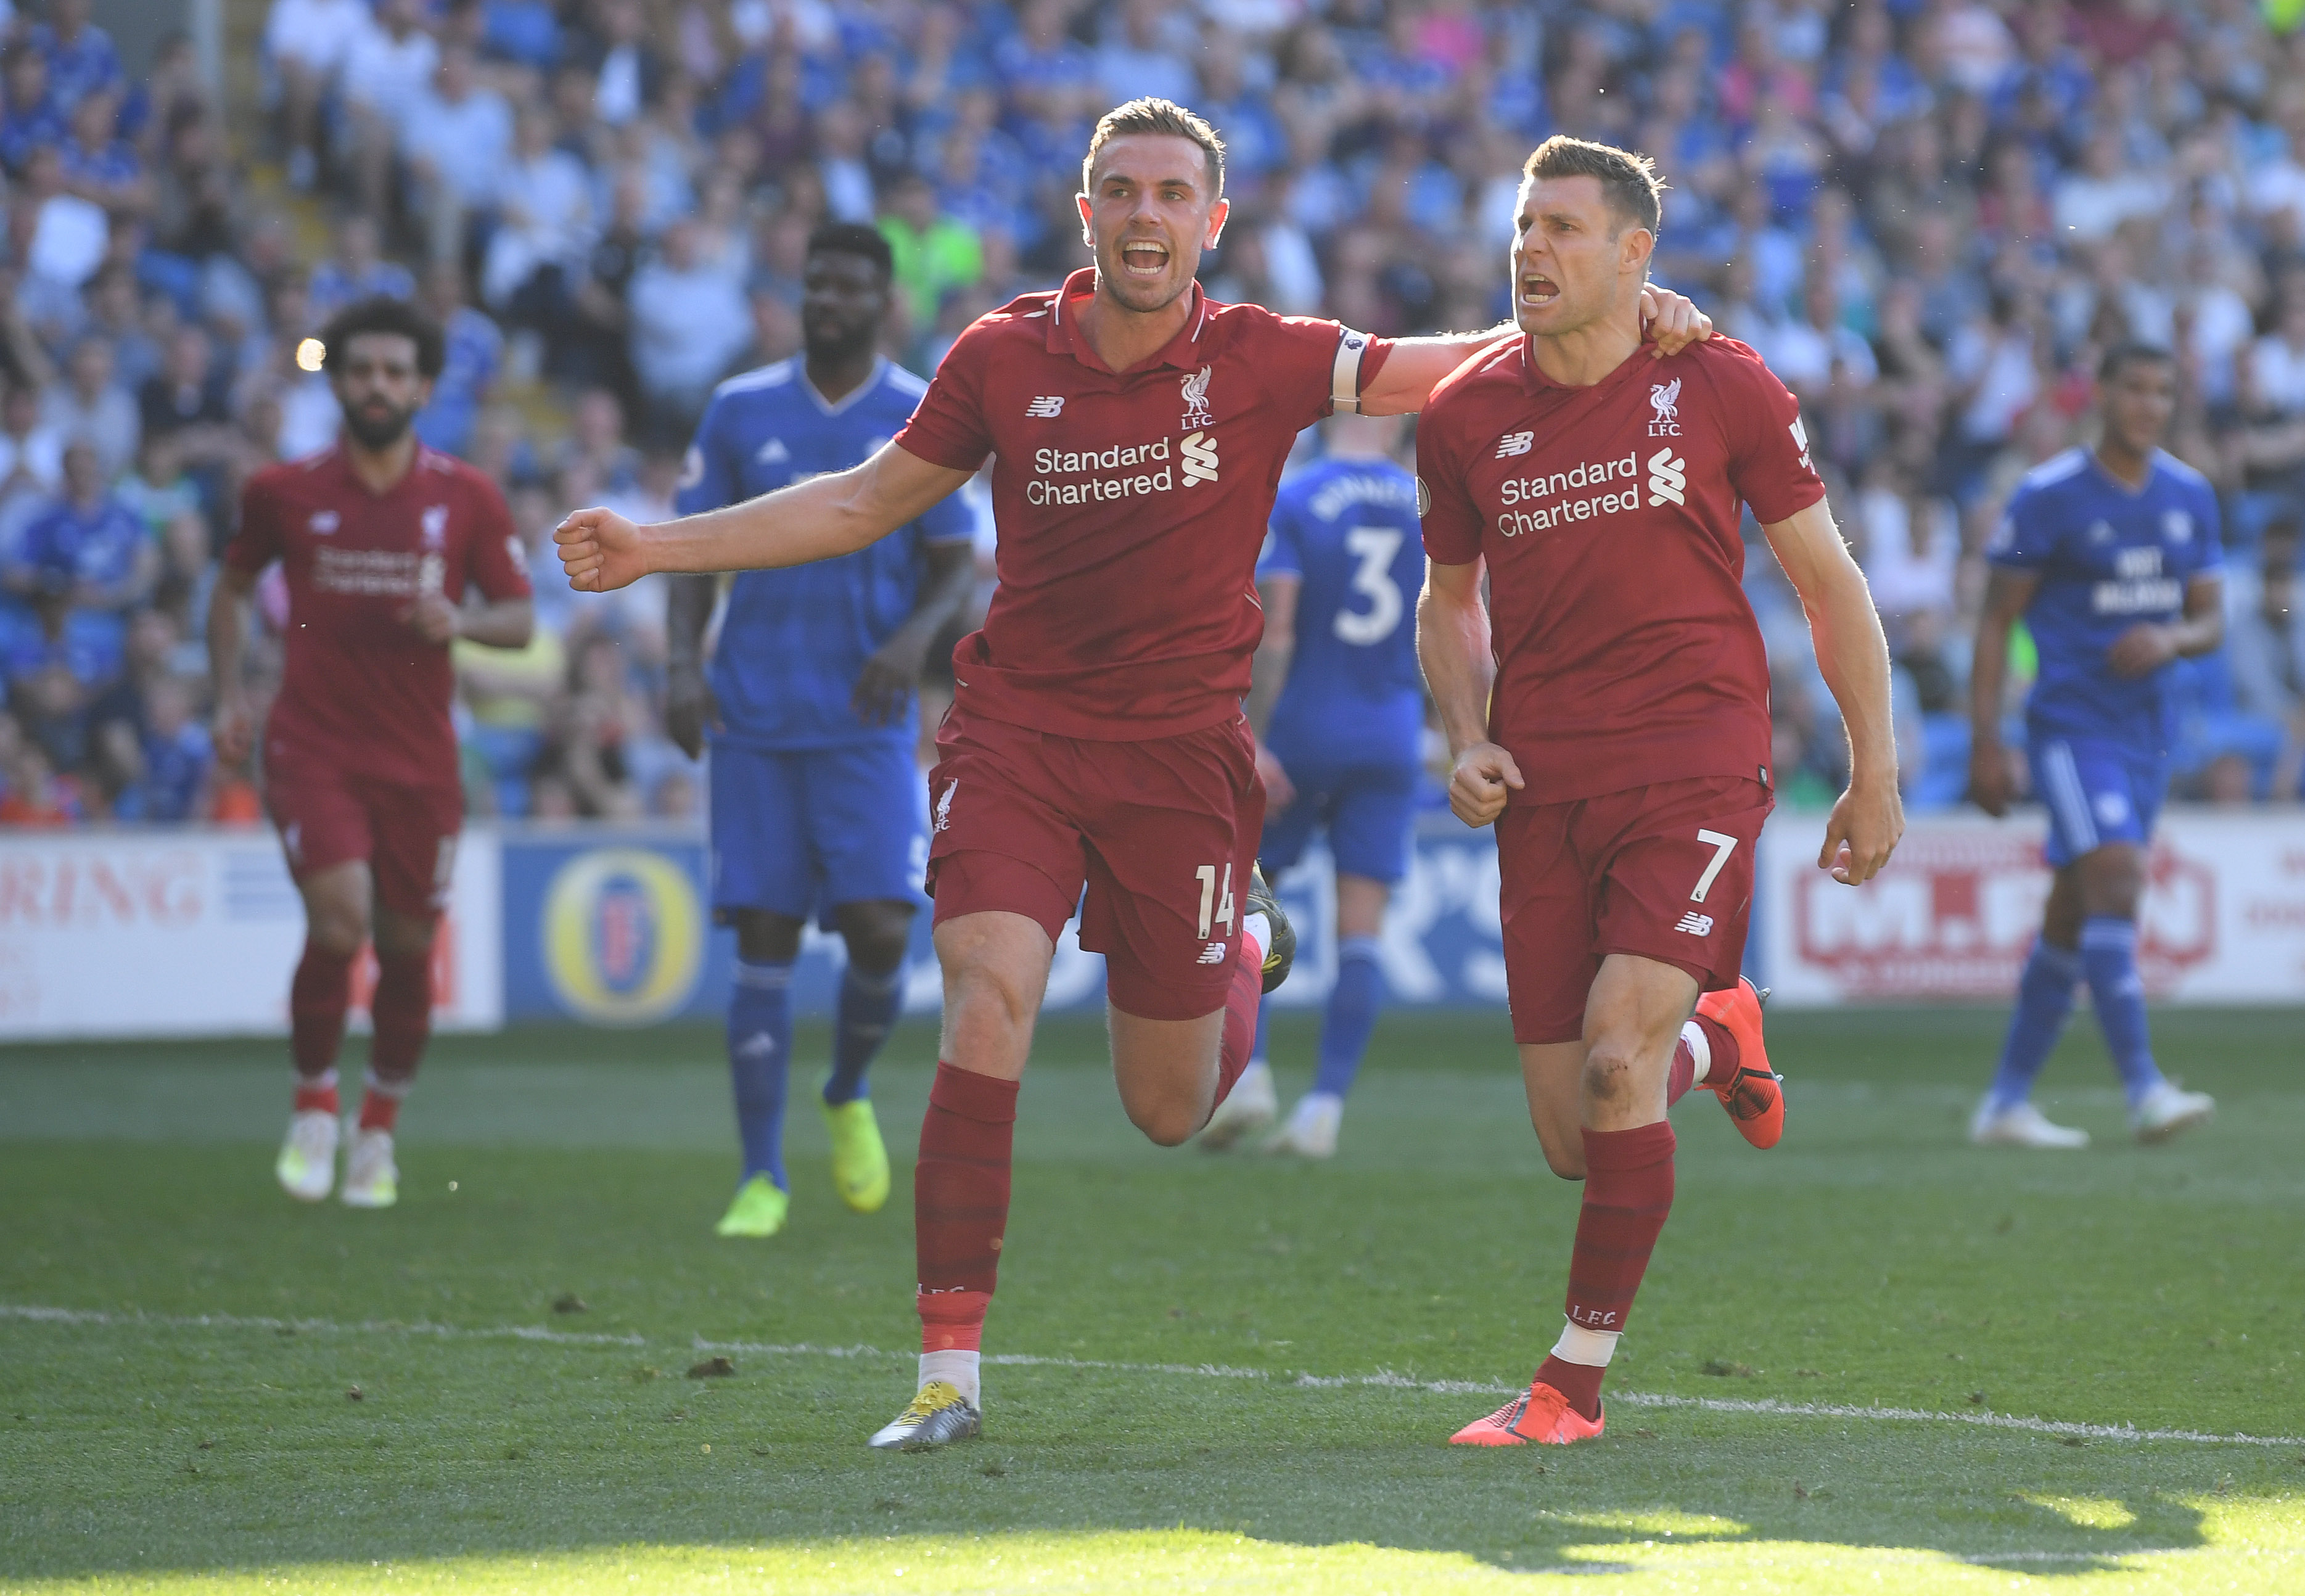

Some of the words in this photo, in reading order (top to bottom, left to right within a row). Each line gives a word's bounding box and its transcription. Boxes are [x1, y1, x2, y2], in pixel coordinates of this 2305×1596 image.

[1034, 436, 1170, 474] Standard
[1500, 451, 1638, 506] Standard
[1026, 465, 1173, 506] Chartered
[1498, 483, 1640, 538] Chartered
[1332, 524, 1406, 648] 3
[1690, 828, 1739, 903] 7
[1195, 862, 1235, 940] 14
